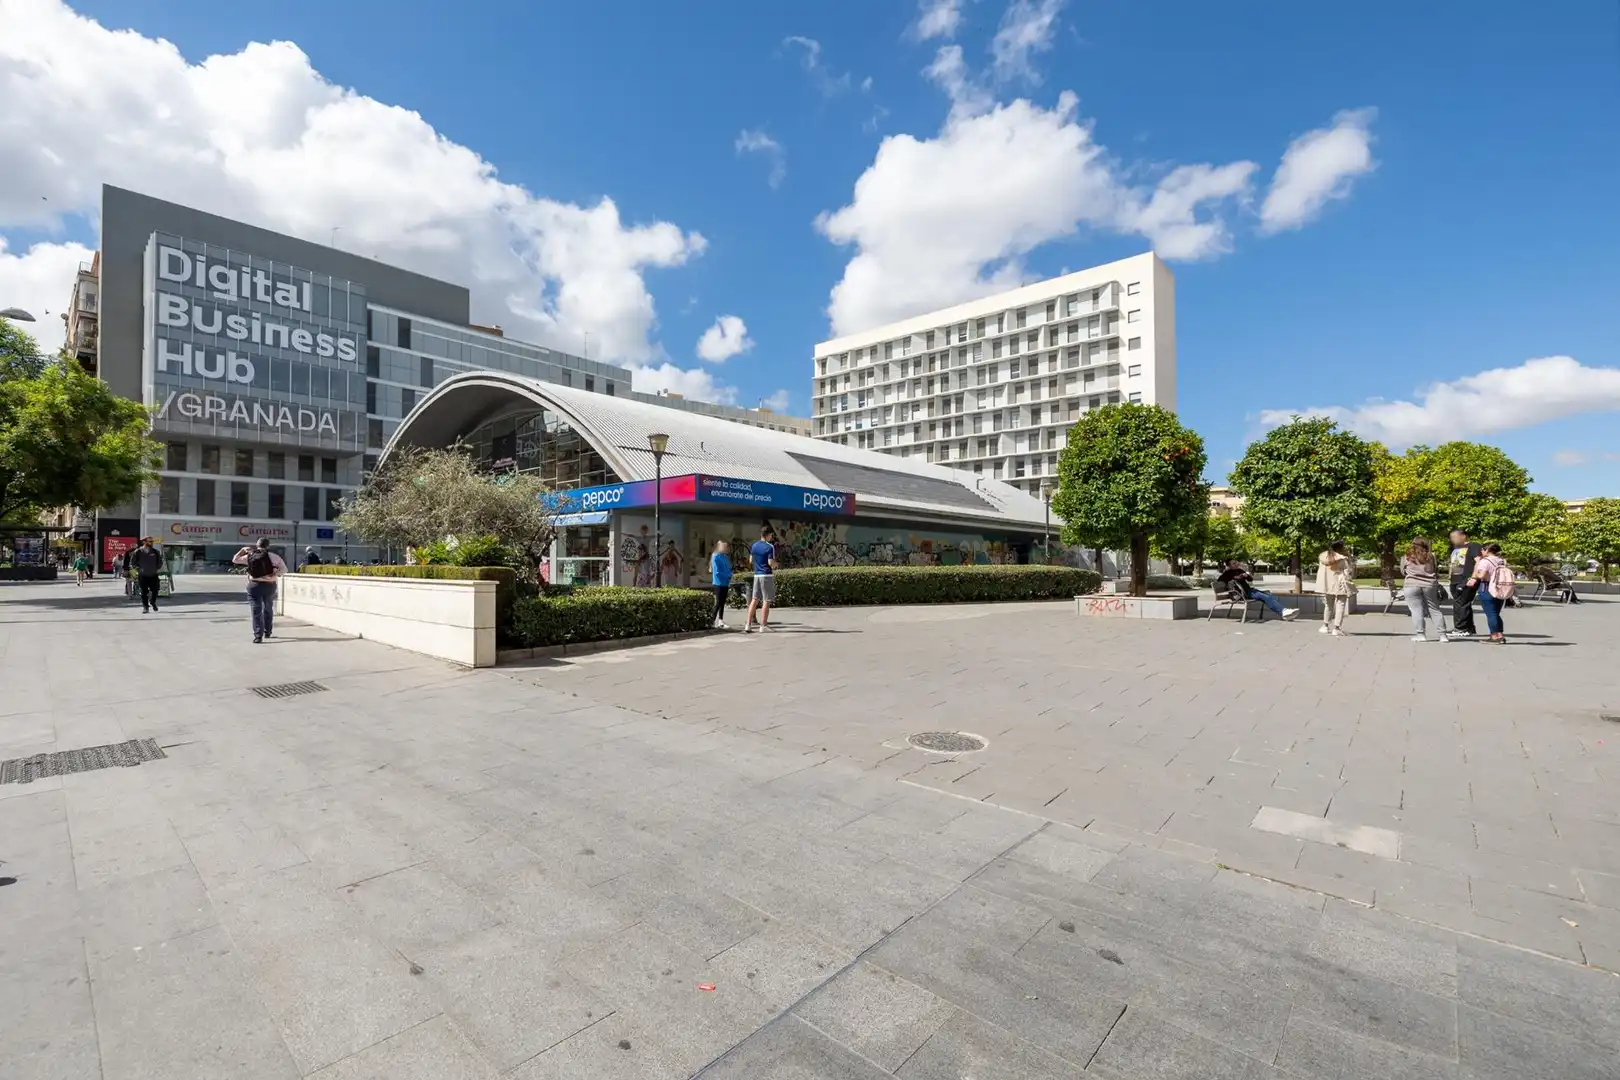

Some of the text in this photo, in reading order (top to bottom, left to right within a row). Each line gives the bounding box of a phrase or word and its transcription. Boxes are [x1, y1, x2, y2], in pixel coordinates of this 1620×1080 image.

[159, 245, 311, 311] Digital
[158, 293, 356, 361] Business
[157, 338, 255, 384] Hub
[703, 479, 721, 487] siente
[722, 480, 728, 488] la
[744, 492, 753, 500] del
[754, 494, 772, 502] precio
